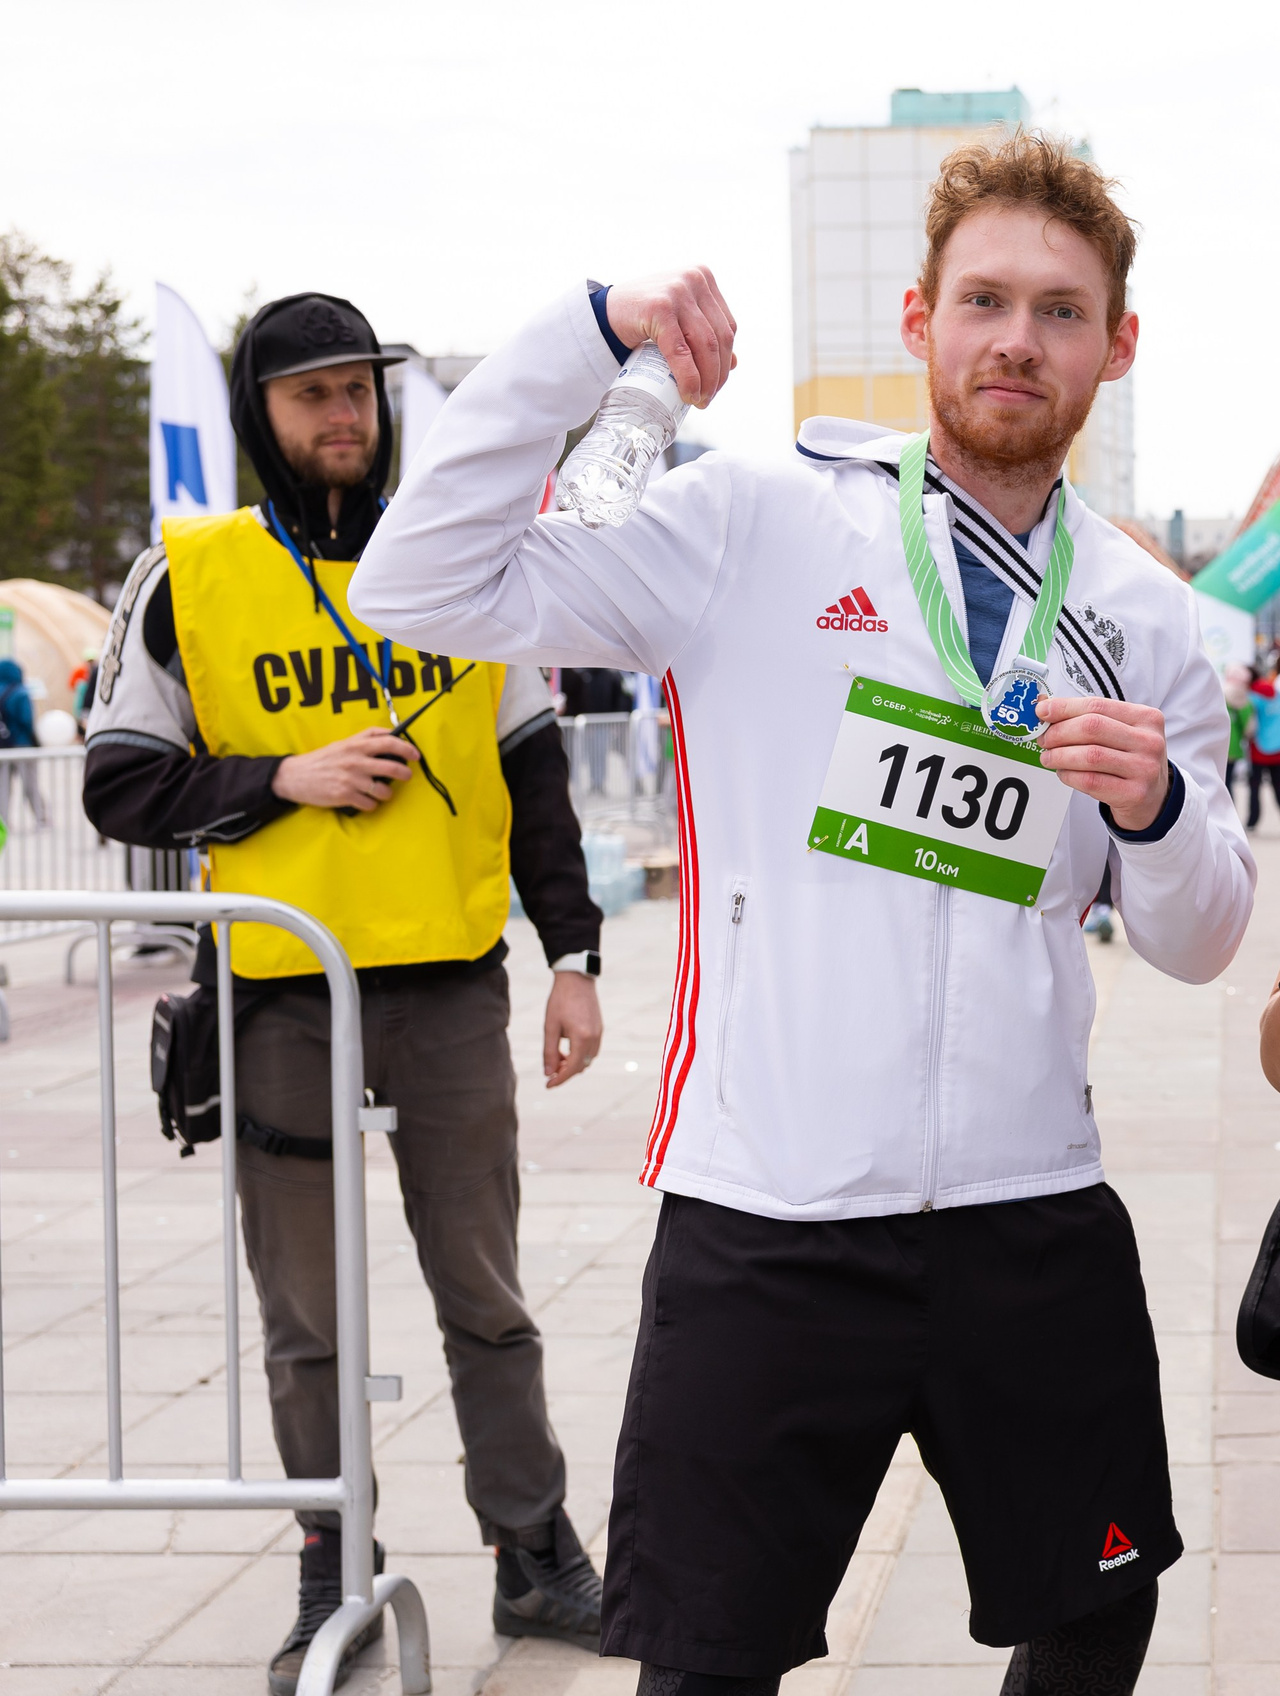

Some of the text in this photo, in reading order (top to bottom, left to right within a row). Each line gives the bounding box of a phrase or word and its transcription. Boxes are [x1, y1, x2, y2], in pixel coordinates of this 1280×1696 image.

[816, 614, 889, 632] adidas
[253, 640, 453, 714] СУДЬЯ
[883, 700, 906, 712] СБЕР
[997, 707, 1019, 723] 50
[995, 730, 1023, 742] НОЯБРЬСК
[878, 743, 1030, 840] 1130
[1098, 1548, 1140, 1572] Reebok
